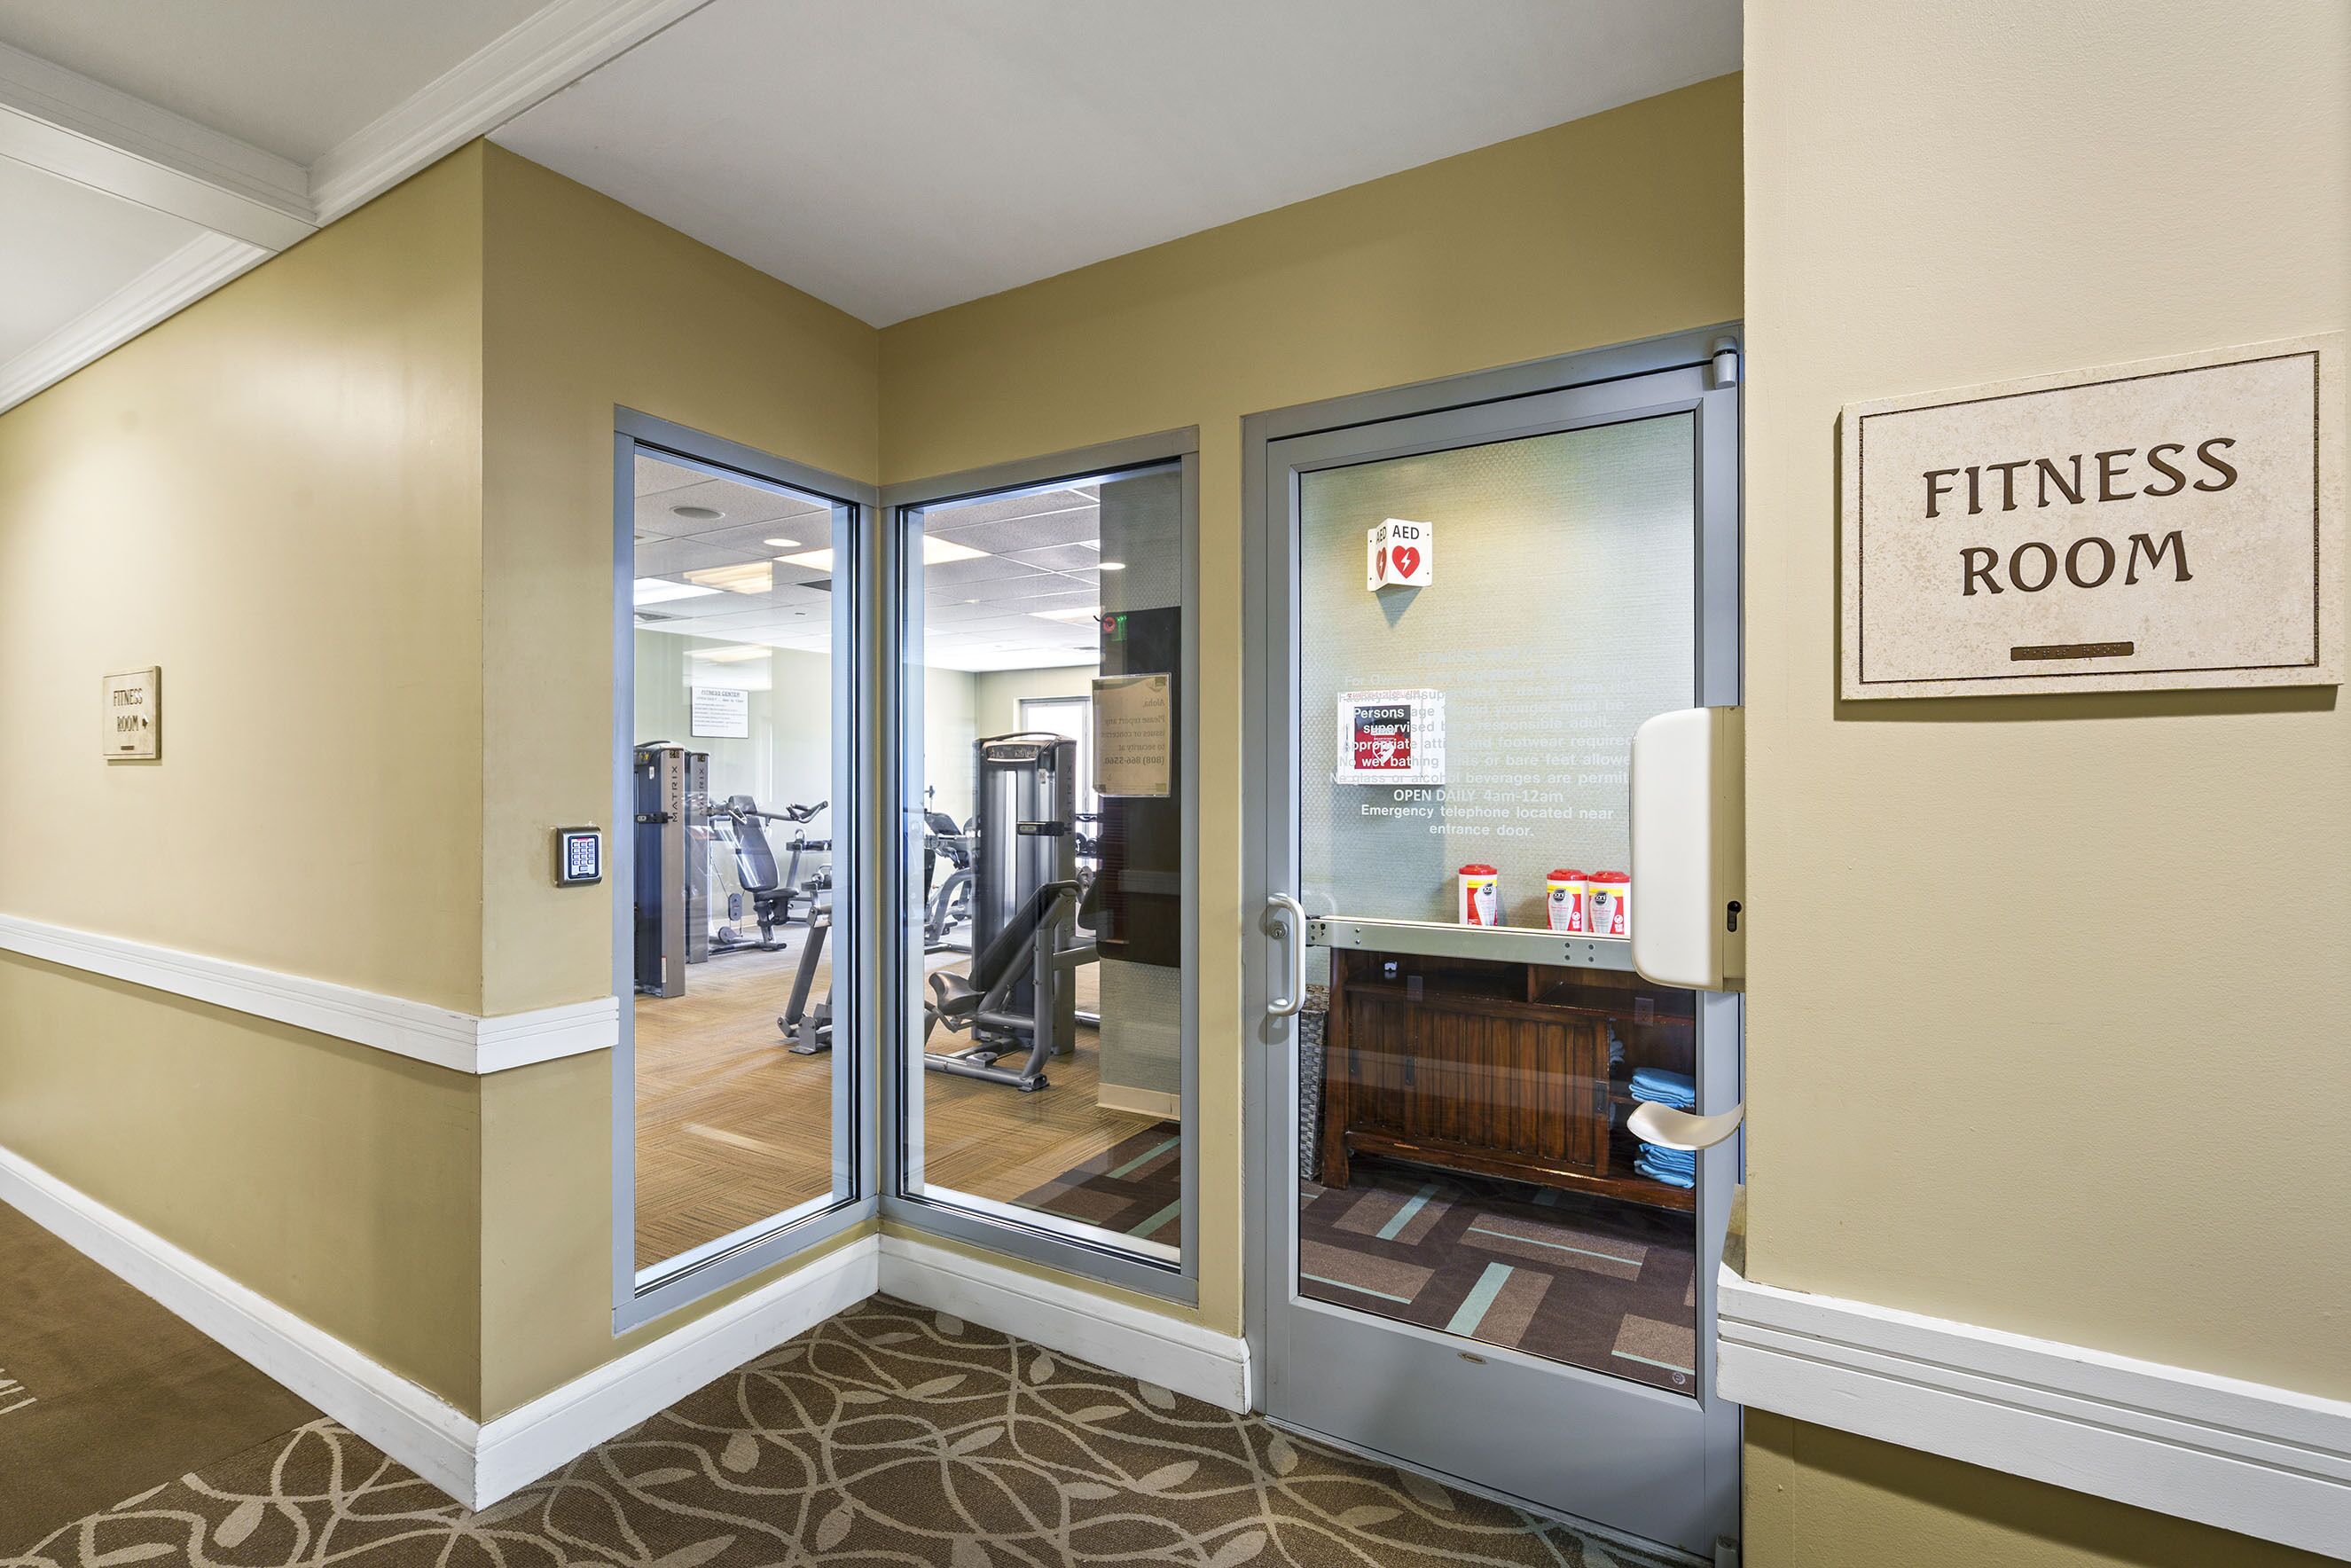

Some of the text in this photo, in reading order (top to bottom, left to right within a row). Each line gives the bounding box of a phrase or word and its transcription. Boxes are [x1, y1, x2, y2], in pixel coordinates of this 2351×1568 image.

[1923, 437, 2238, 519] FITNESS
[1392, 525, 1420, 540] AED
[1959, 530, 2193, 596] ROOM
[1344, 676, 1364, 686] For
[114, 687, 143, 706] FITNESS
[1353, 708, 1405, 718] Persons
[1411, 707, 1435, 717] age
[1605, 699, 1625, 711] be
[117, 715, 139, 733] ROOM
[1363, 721, 1435, 734] supervised
[1476, 717, 1563, 733] responsible
[1498, 736, 1563, 749] footwear
[1339, 757, 1356, 767] No
[1362, 757, 1385, 767] wet
[1390, 756, 1439, 769] bathing
[1486, 757, 1501, 766] or
[1506, 754, 1539, 766] bare
[1546, 754, 1576, 765] feet
[1583, 753, 1631, 766] allowe
[1354, 772, 1386, 786] glass
[1391, 773, 1405, 783] or
[1414, 772, 1461, 783] alcohol
[1466, 772, 1540, 786] beverages
[1548, 773, 1571, 784] are
[1579, 771, 1628, 785] permit
[1393, 789, 1563, 803] OPEN DAILY 4am-12am
[1361, 804, 1614, 819] Emergency telephone located near
[1429, 824, 1535, 836] entrance door.
